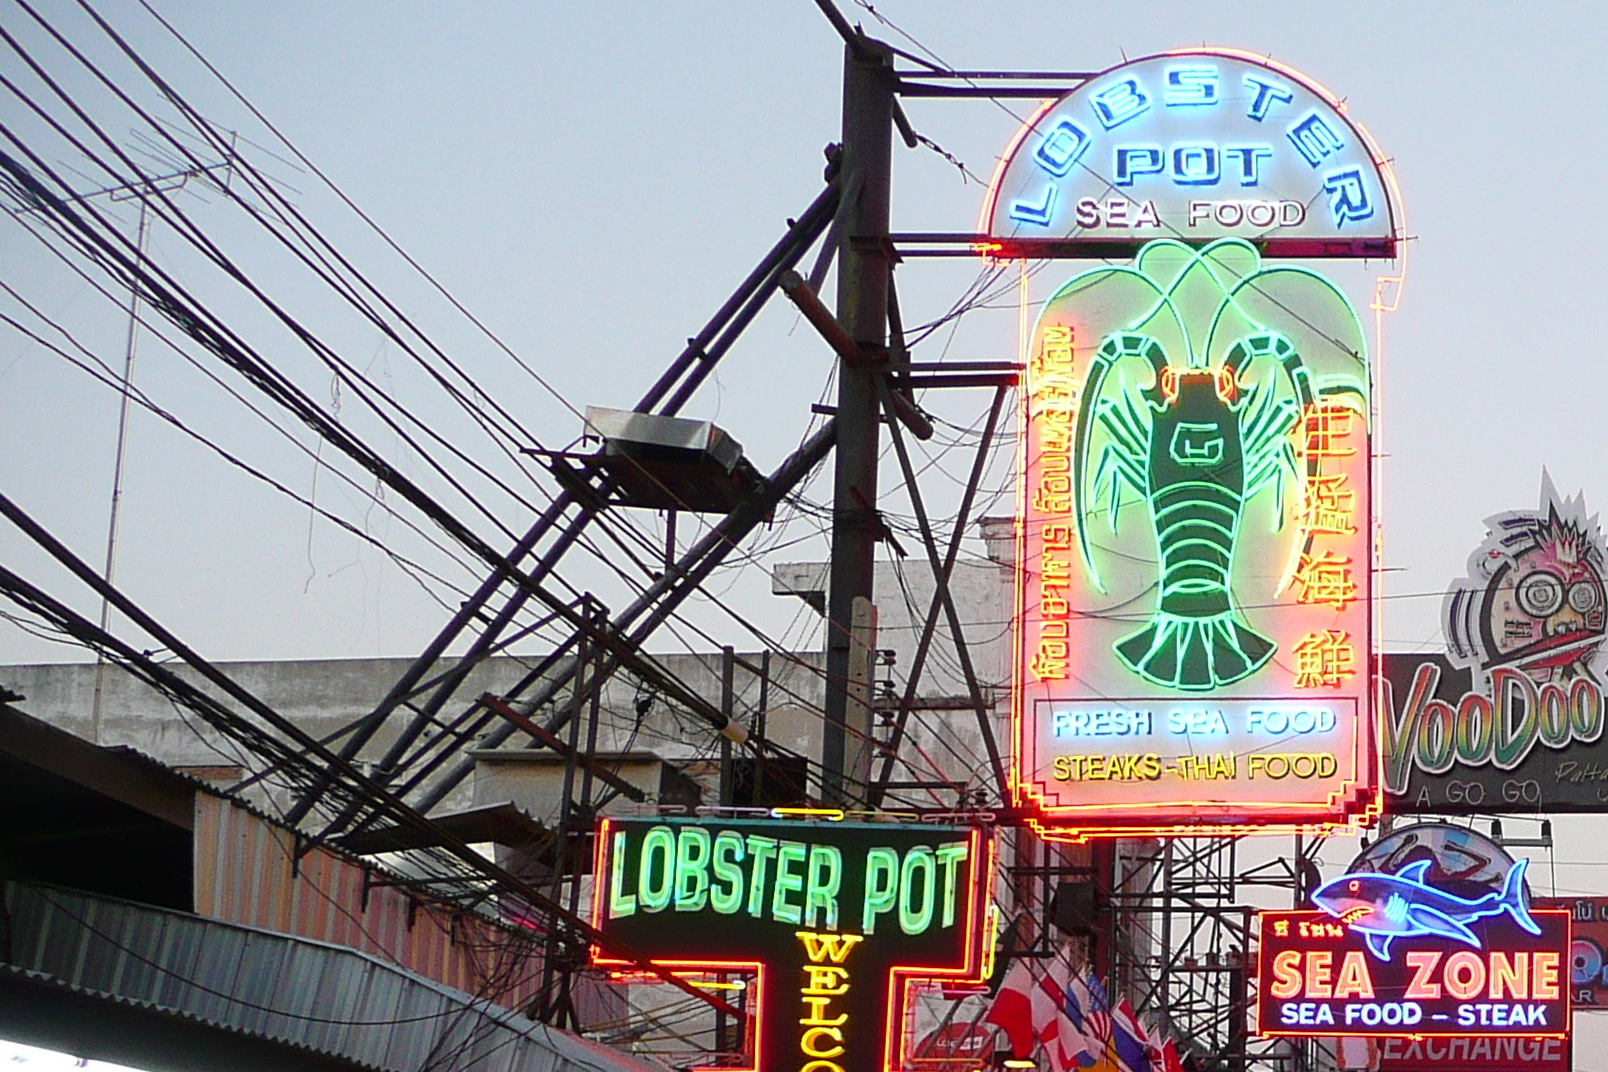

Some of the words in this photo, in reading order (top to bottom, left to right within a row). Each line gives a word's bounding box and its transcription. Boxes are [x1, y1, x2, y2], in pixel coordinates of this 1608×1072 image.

[1010, 64, 1374, 228] LOBSTER
[1113, 141, 1272, 186] POT
[1076, 199, 1161, 228] SEA
[1188, 199, 1306, 228] FOOD
[1052, 708, 1153, 736] FRESH
[1168, 708, 1229, 735] SEA
[1246, 706, 1337, 734] FOOD
[1248, 752, 1338, 779] FOOD
[1416, 786, 1431, 807] A
[1446, 780, 1486, 805] GO
[1502, 779, 1542, 806] GO
[609, 825, 842, 931] LOBSTER
[863, 839, 969, 935] POT
[1270, 950, 1375, 1000] SEA
[1404, 951, 1560, 1000] ZONE
[1281, 1003, 1335, 1027] SEA
[1345, 1002, 1423, 1026] FOOD
[1457, 1004, 1548, 1027] STEAK
